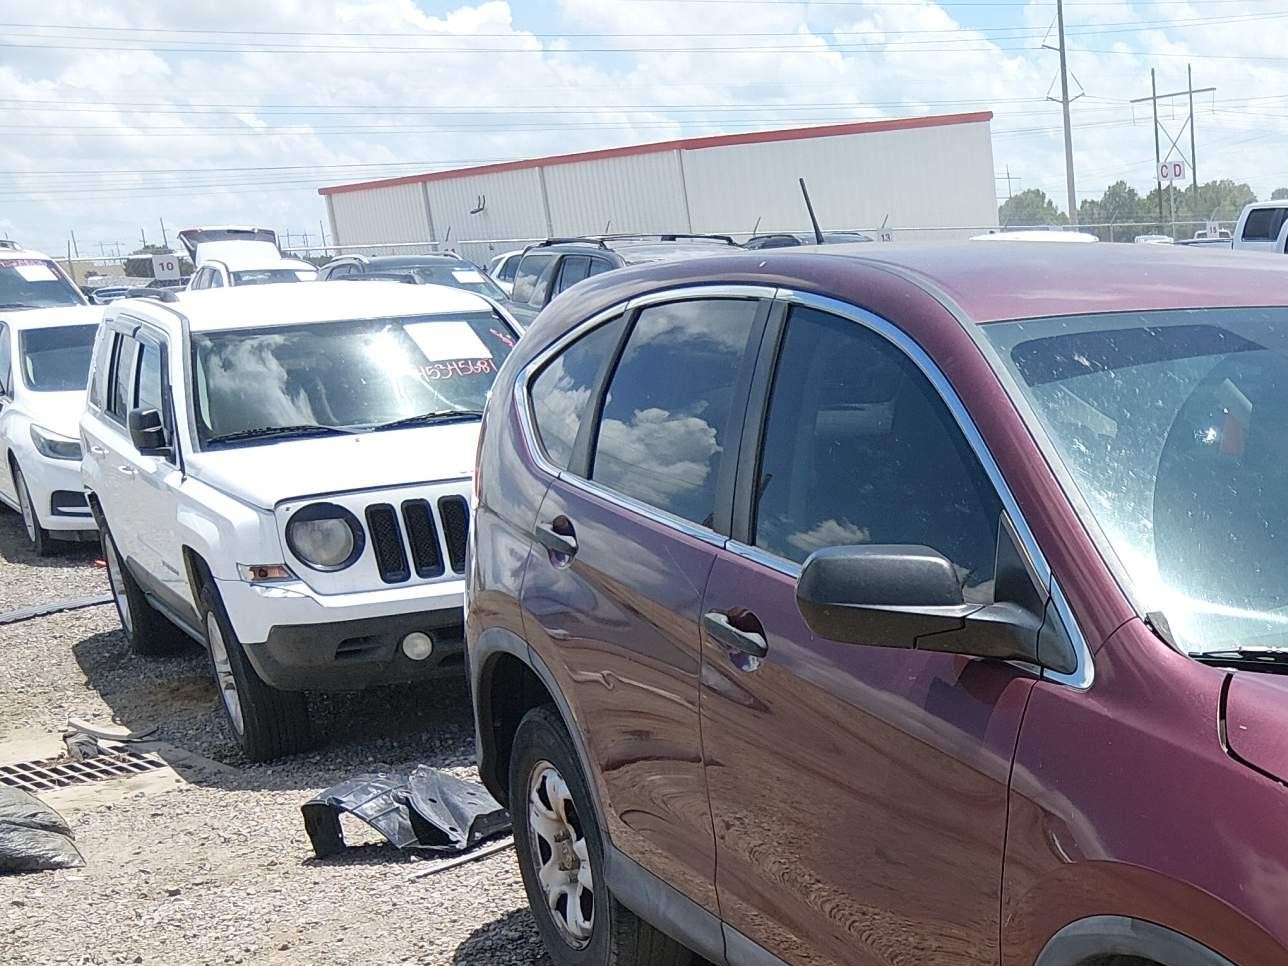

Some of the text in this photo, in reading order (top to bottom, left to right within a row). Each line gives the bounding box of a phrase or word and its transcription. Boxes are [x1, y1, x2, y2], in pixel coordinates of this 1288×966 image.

[1160, 163, 1182, 178] C D
[159, 262, 174, 271] 10
